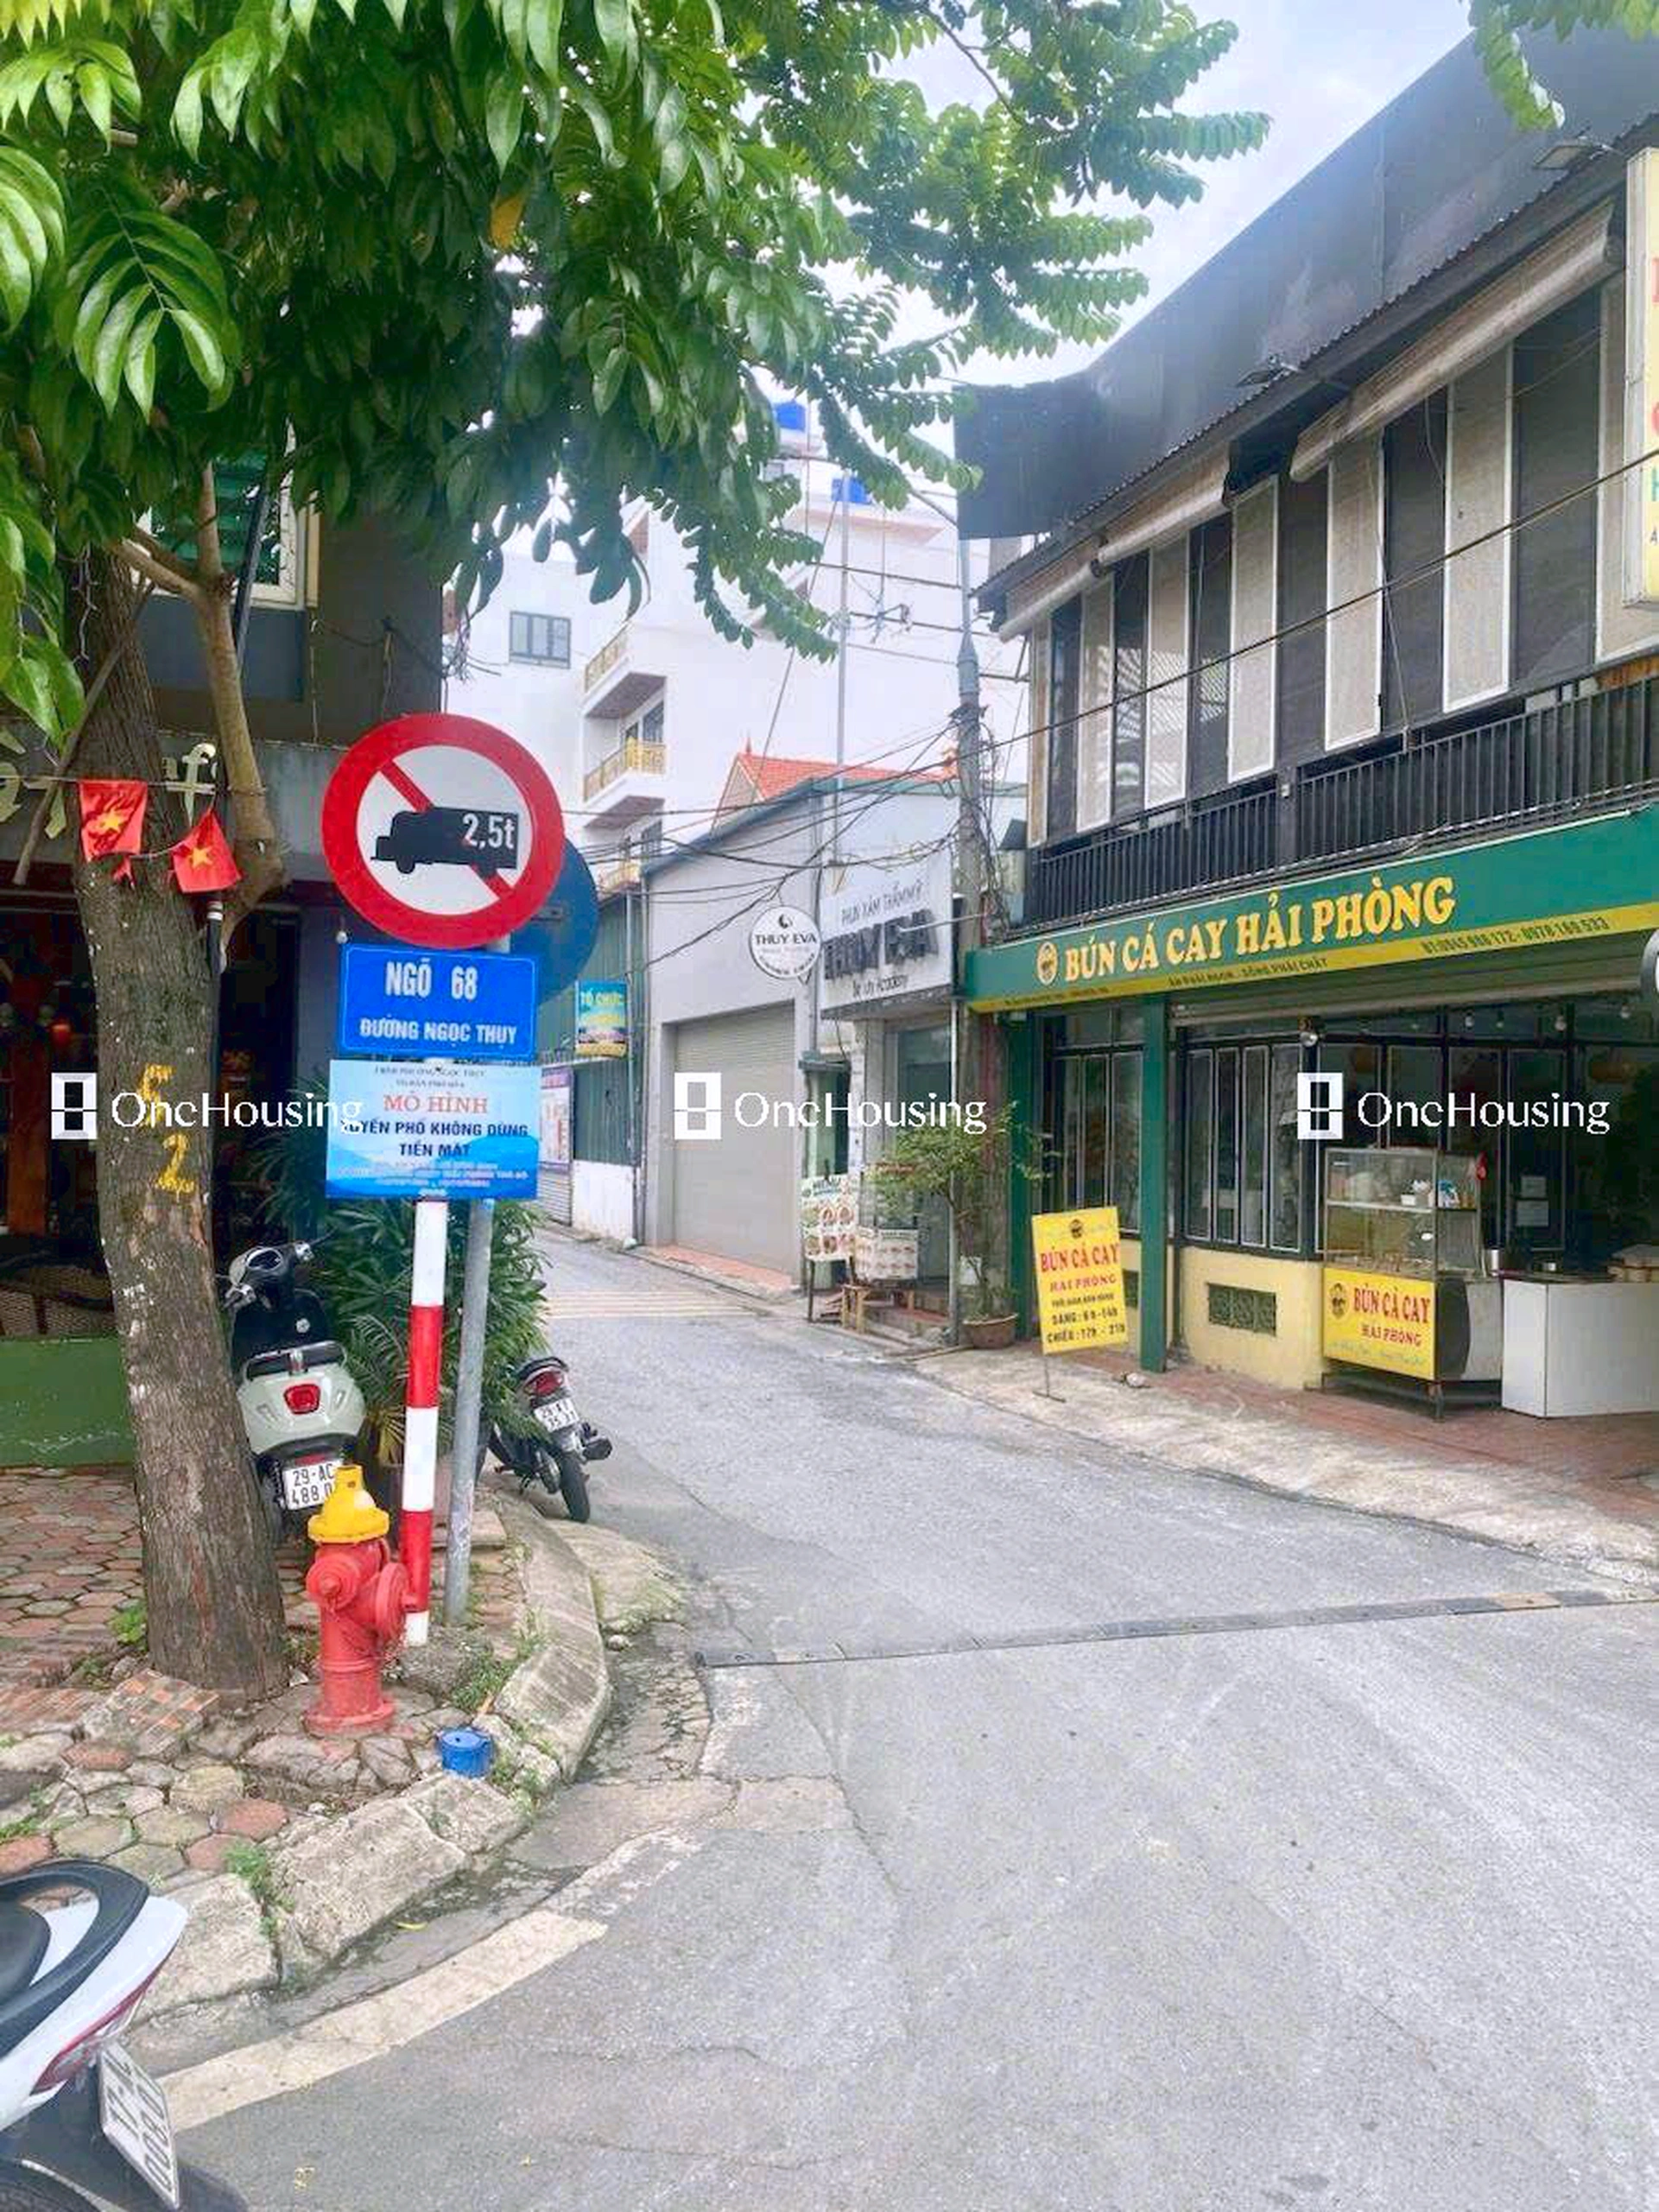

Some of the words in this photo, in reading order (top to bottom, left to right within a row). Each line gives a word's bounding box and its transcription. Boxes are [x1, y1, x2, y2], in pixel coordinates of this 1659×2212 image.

[755, 934, 789, 945] THUY
[794, 933, 817, 944] EVA
[1065, 934, 1116, 982] BÚN
[1122, 922, 1160, 973] CÁ
[1166, 918, 1228, 966] CAY
[1236, 891, 1303, 954] HẢI
[1312, 876, 1456, 944] PHÒNG
[386, 958, 431, 998] NGÕ
[452, 966, 478, 999] 68
[360, 1013, 419, 1040] ĐƯỜNG
[424, 1022, 472, 1047] NGỌC
[384, 1091, 421, 1112] MÔ
[427, 1091, 488, 1114] HÌNH
[396, 1117, 425, 1135] PHỐ
[431, 1120, 482, 1137] KHÔNG
[1041, 1245, 1067, 1273] BÚN
[1072, 1241, 1089, 1269] CÁ
[1092, 1243, 1121, 1265] CAY
[1353, 1283, 1380, 1314] BÚN
[1383, 1286, 1400, 1319] CÁ
[1403, 1294, 1431, 1324] CAY
